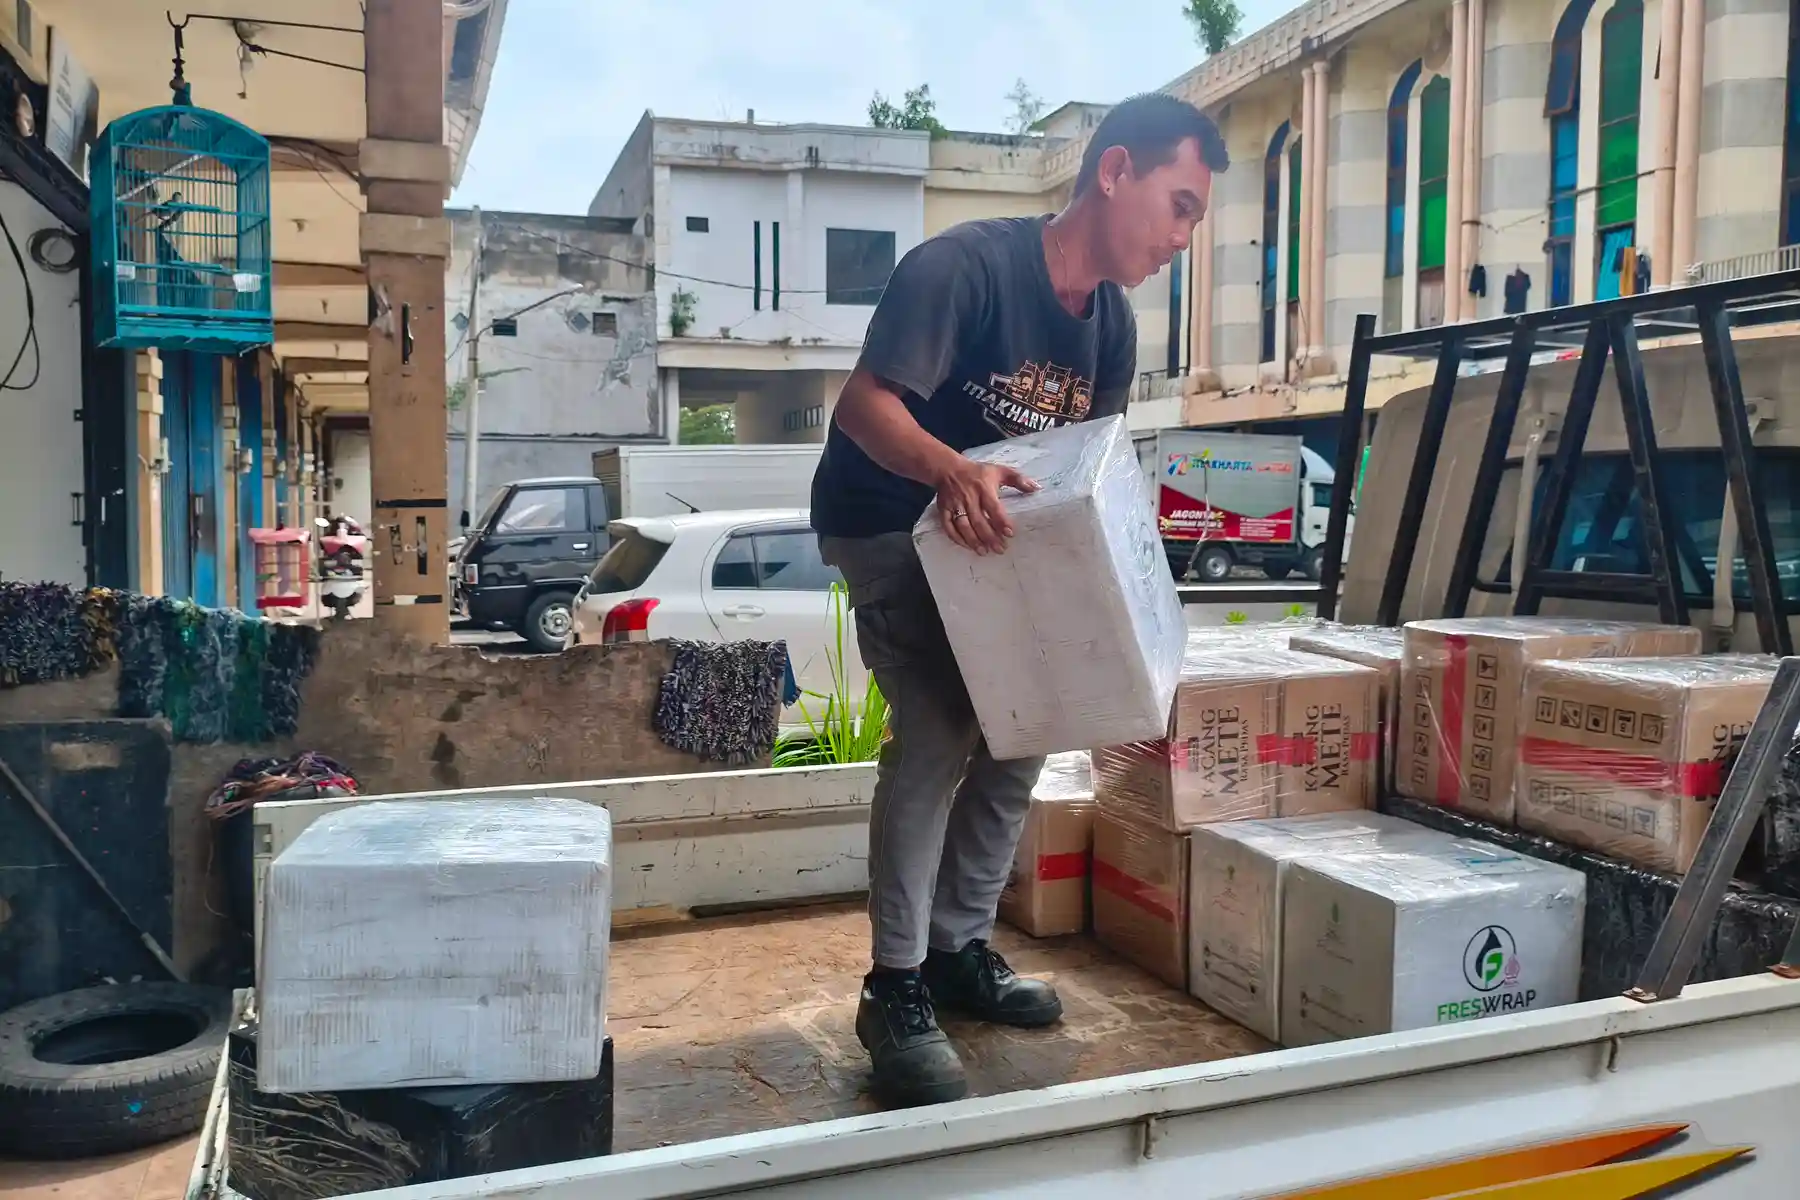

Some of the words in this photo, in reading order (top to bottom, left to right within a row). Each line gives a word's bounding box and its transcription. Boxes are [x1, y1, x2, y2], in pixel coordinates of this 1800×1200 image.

[1201, 708, 1216, 799] KACANG
[1218, 705, 1240, 796] METE
[1305, 705, 1319, 793] KANG
[1321, 702, 1342, 789] METE
[1436, 989, 1537, 1023] FRESWRAP
